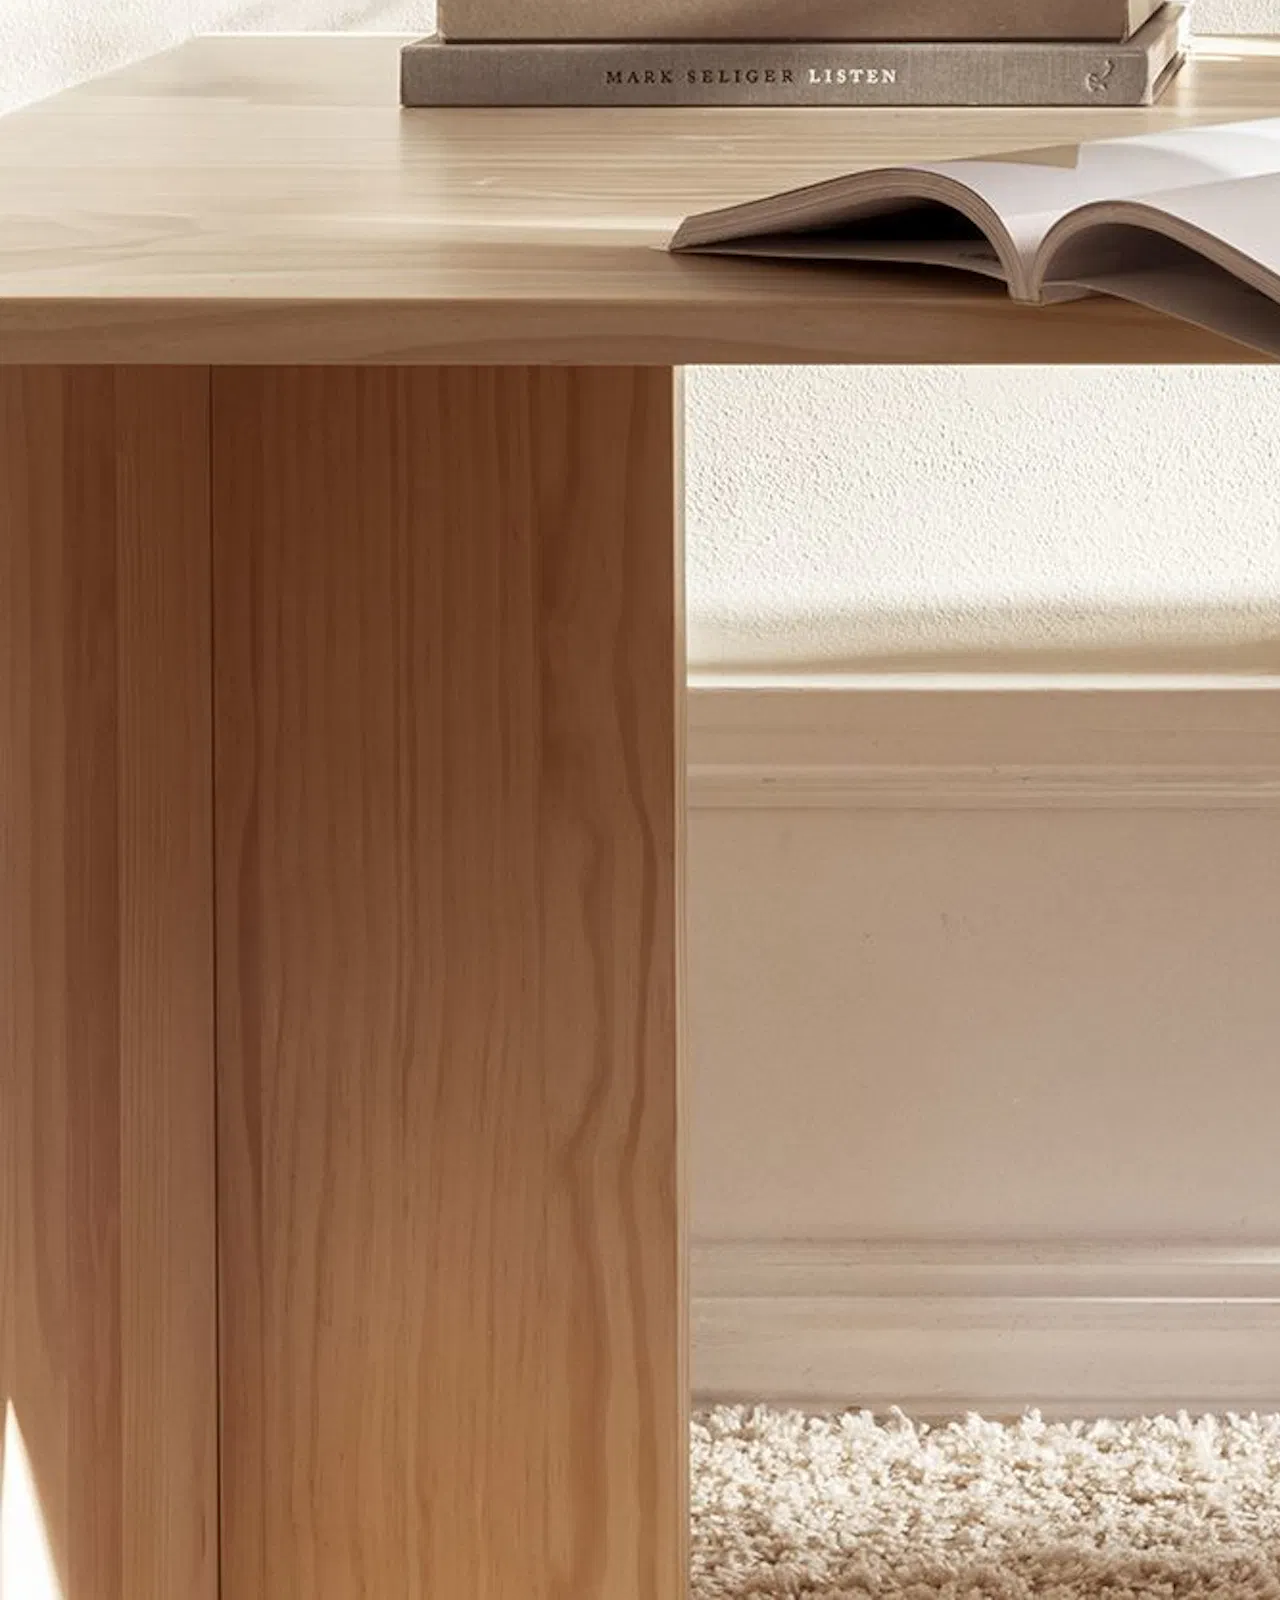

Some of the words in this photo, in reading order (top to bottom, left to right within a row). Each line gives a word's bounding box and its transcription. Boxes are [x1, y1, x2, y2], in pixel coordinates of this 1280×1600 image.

[605, 70, 673, 84] MARK
[687, 69, 794, 84] SELIGER
[808, 68, 898, 84] LISTEN
